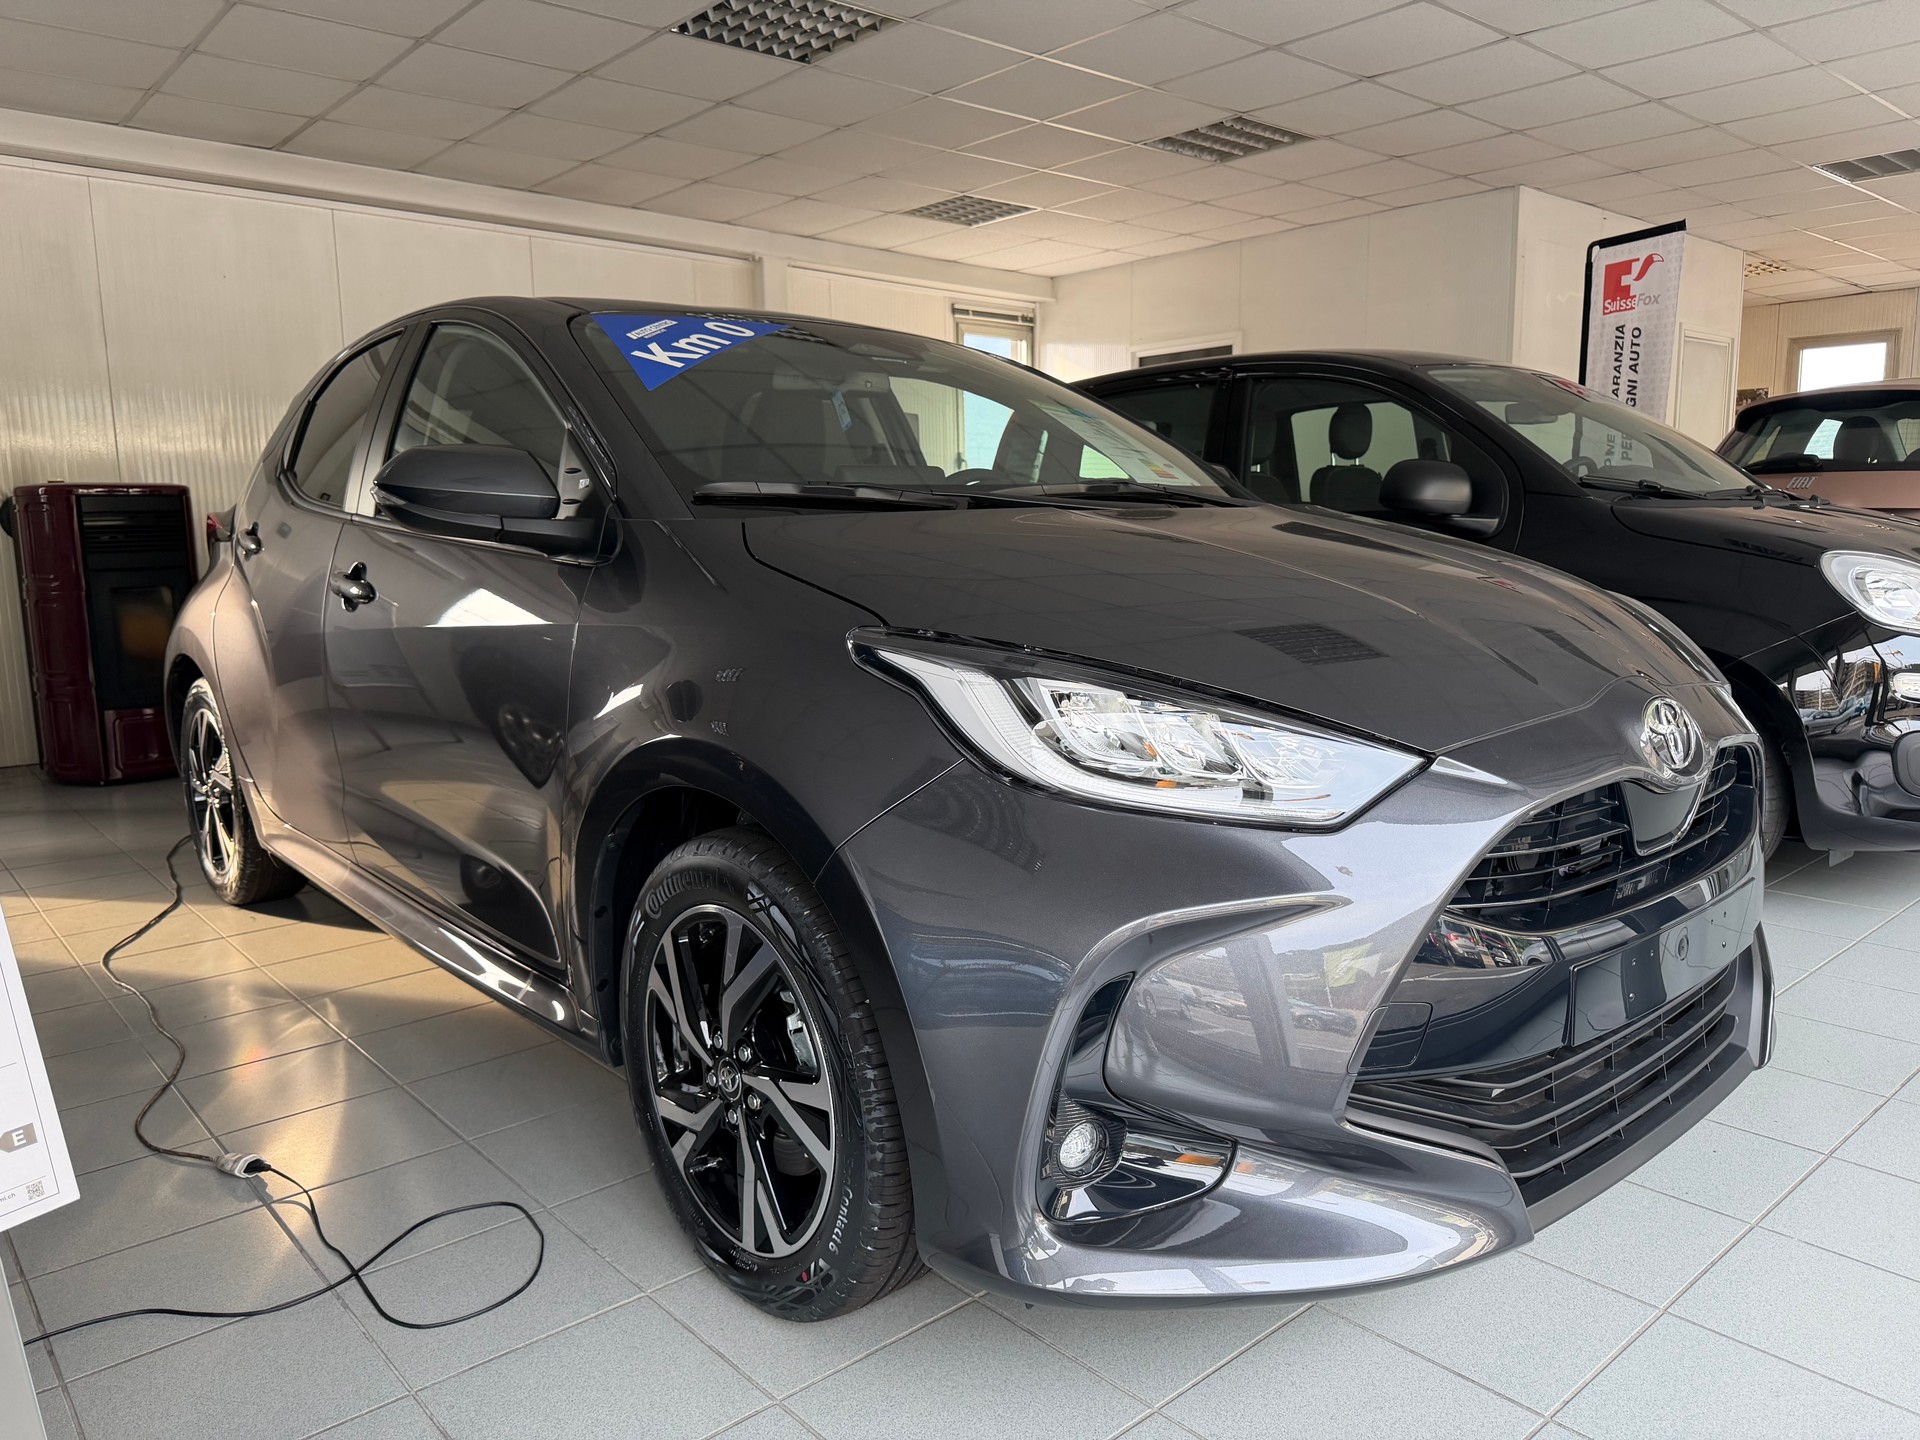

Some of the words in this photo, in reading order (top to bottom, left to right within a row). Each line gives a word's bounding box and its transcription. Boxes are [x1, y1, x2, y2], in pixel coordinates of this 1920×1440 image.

[630, 334, 732, 368] Km
[1611, 324, 1626, 398] ARANZIA
[1628, 326, 1642, 374] AUTO
[1625, 379, 1638, 408] GNI
[1786, 476, 1818, 489] FIAT
[12, 1130, 26, 1146] E
[828, 1241, 839, 1255] 6
